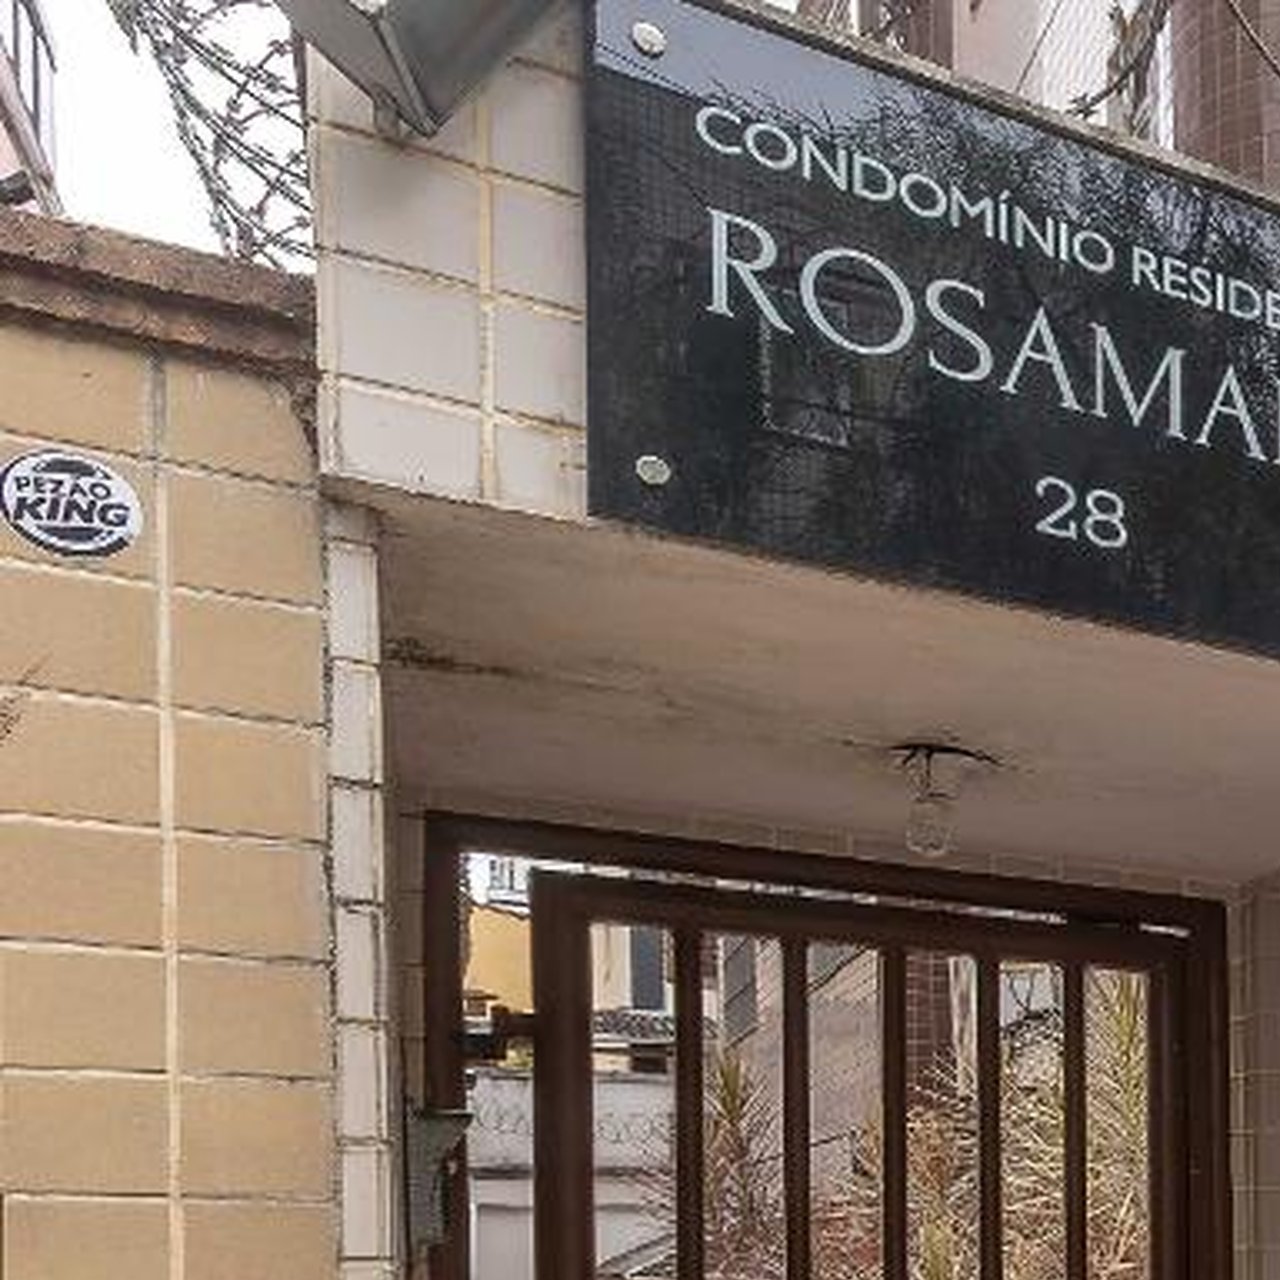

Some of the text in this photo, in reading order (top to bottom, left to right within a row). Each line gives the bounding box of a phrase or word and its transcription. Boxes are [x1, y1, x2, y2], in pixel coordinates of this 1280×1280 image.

[694, 105, 1116, 274] CONDOMÍNIO
[13, 496, 130, 528] KING
[1034, 476, 1129, 549] 28
